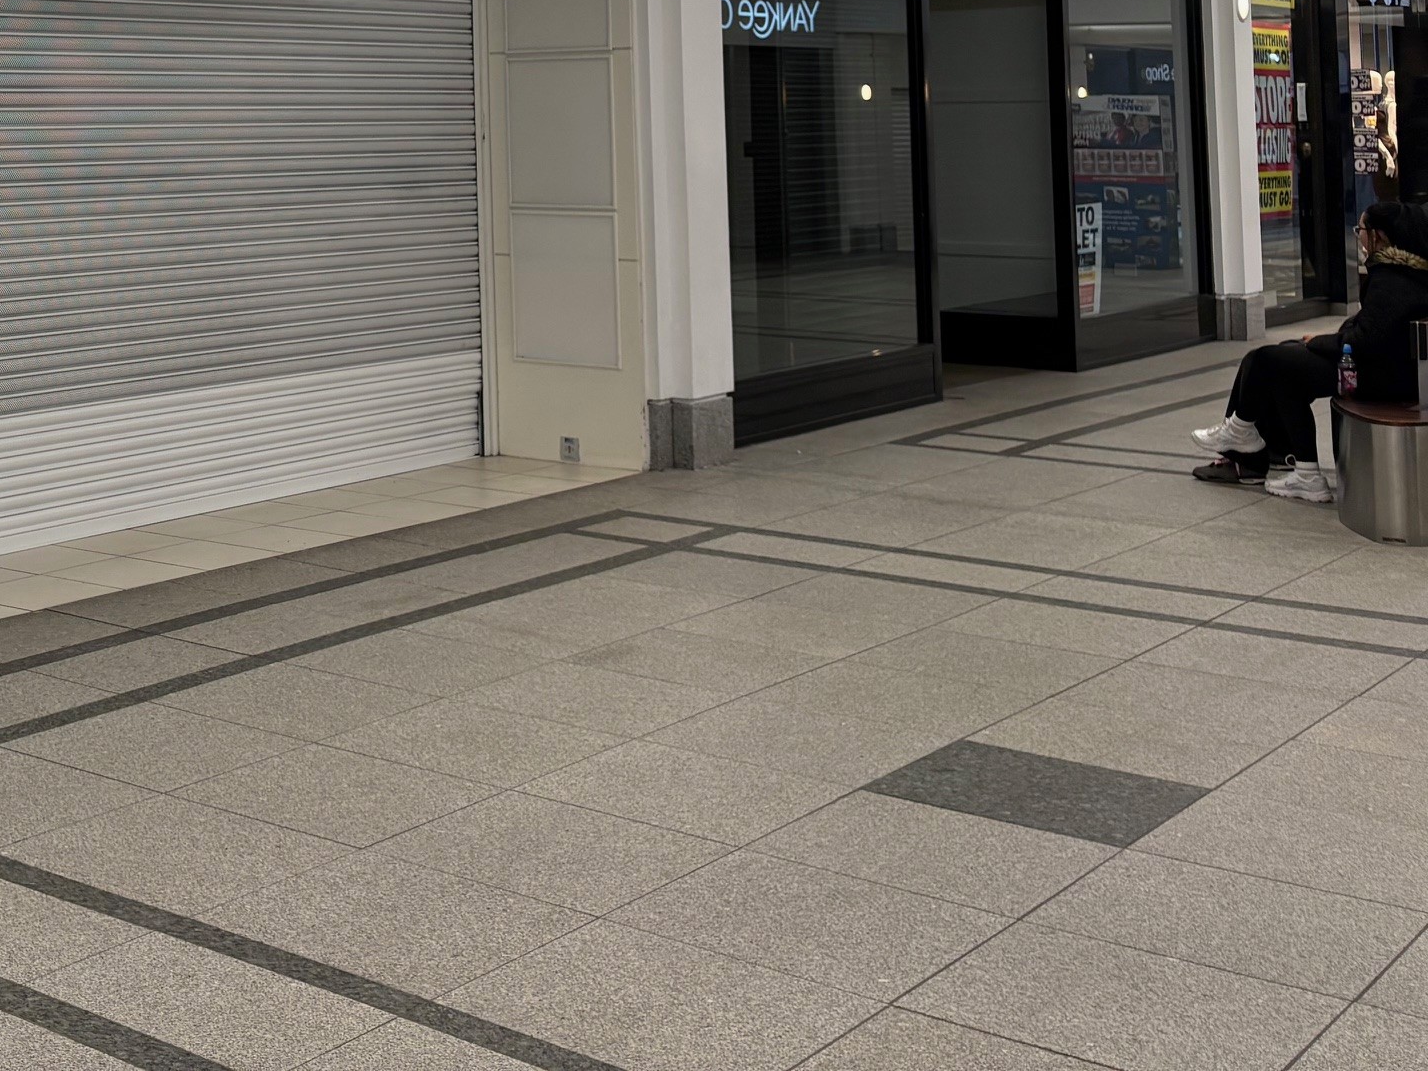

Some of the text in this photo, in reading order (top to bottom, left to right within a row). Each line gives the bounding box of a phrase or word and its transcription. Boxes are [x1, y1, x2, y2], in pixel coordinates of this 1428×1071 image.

[1253, 33, 1288, 48] EVERYTHING
[1258, 175, 1291, 189] VERYTHING
[1076, 205, 1095, 228] TO
